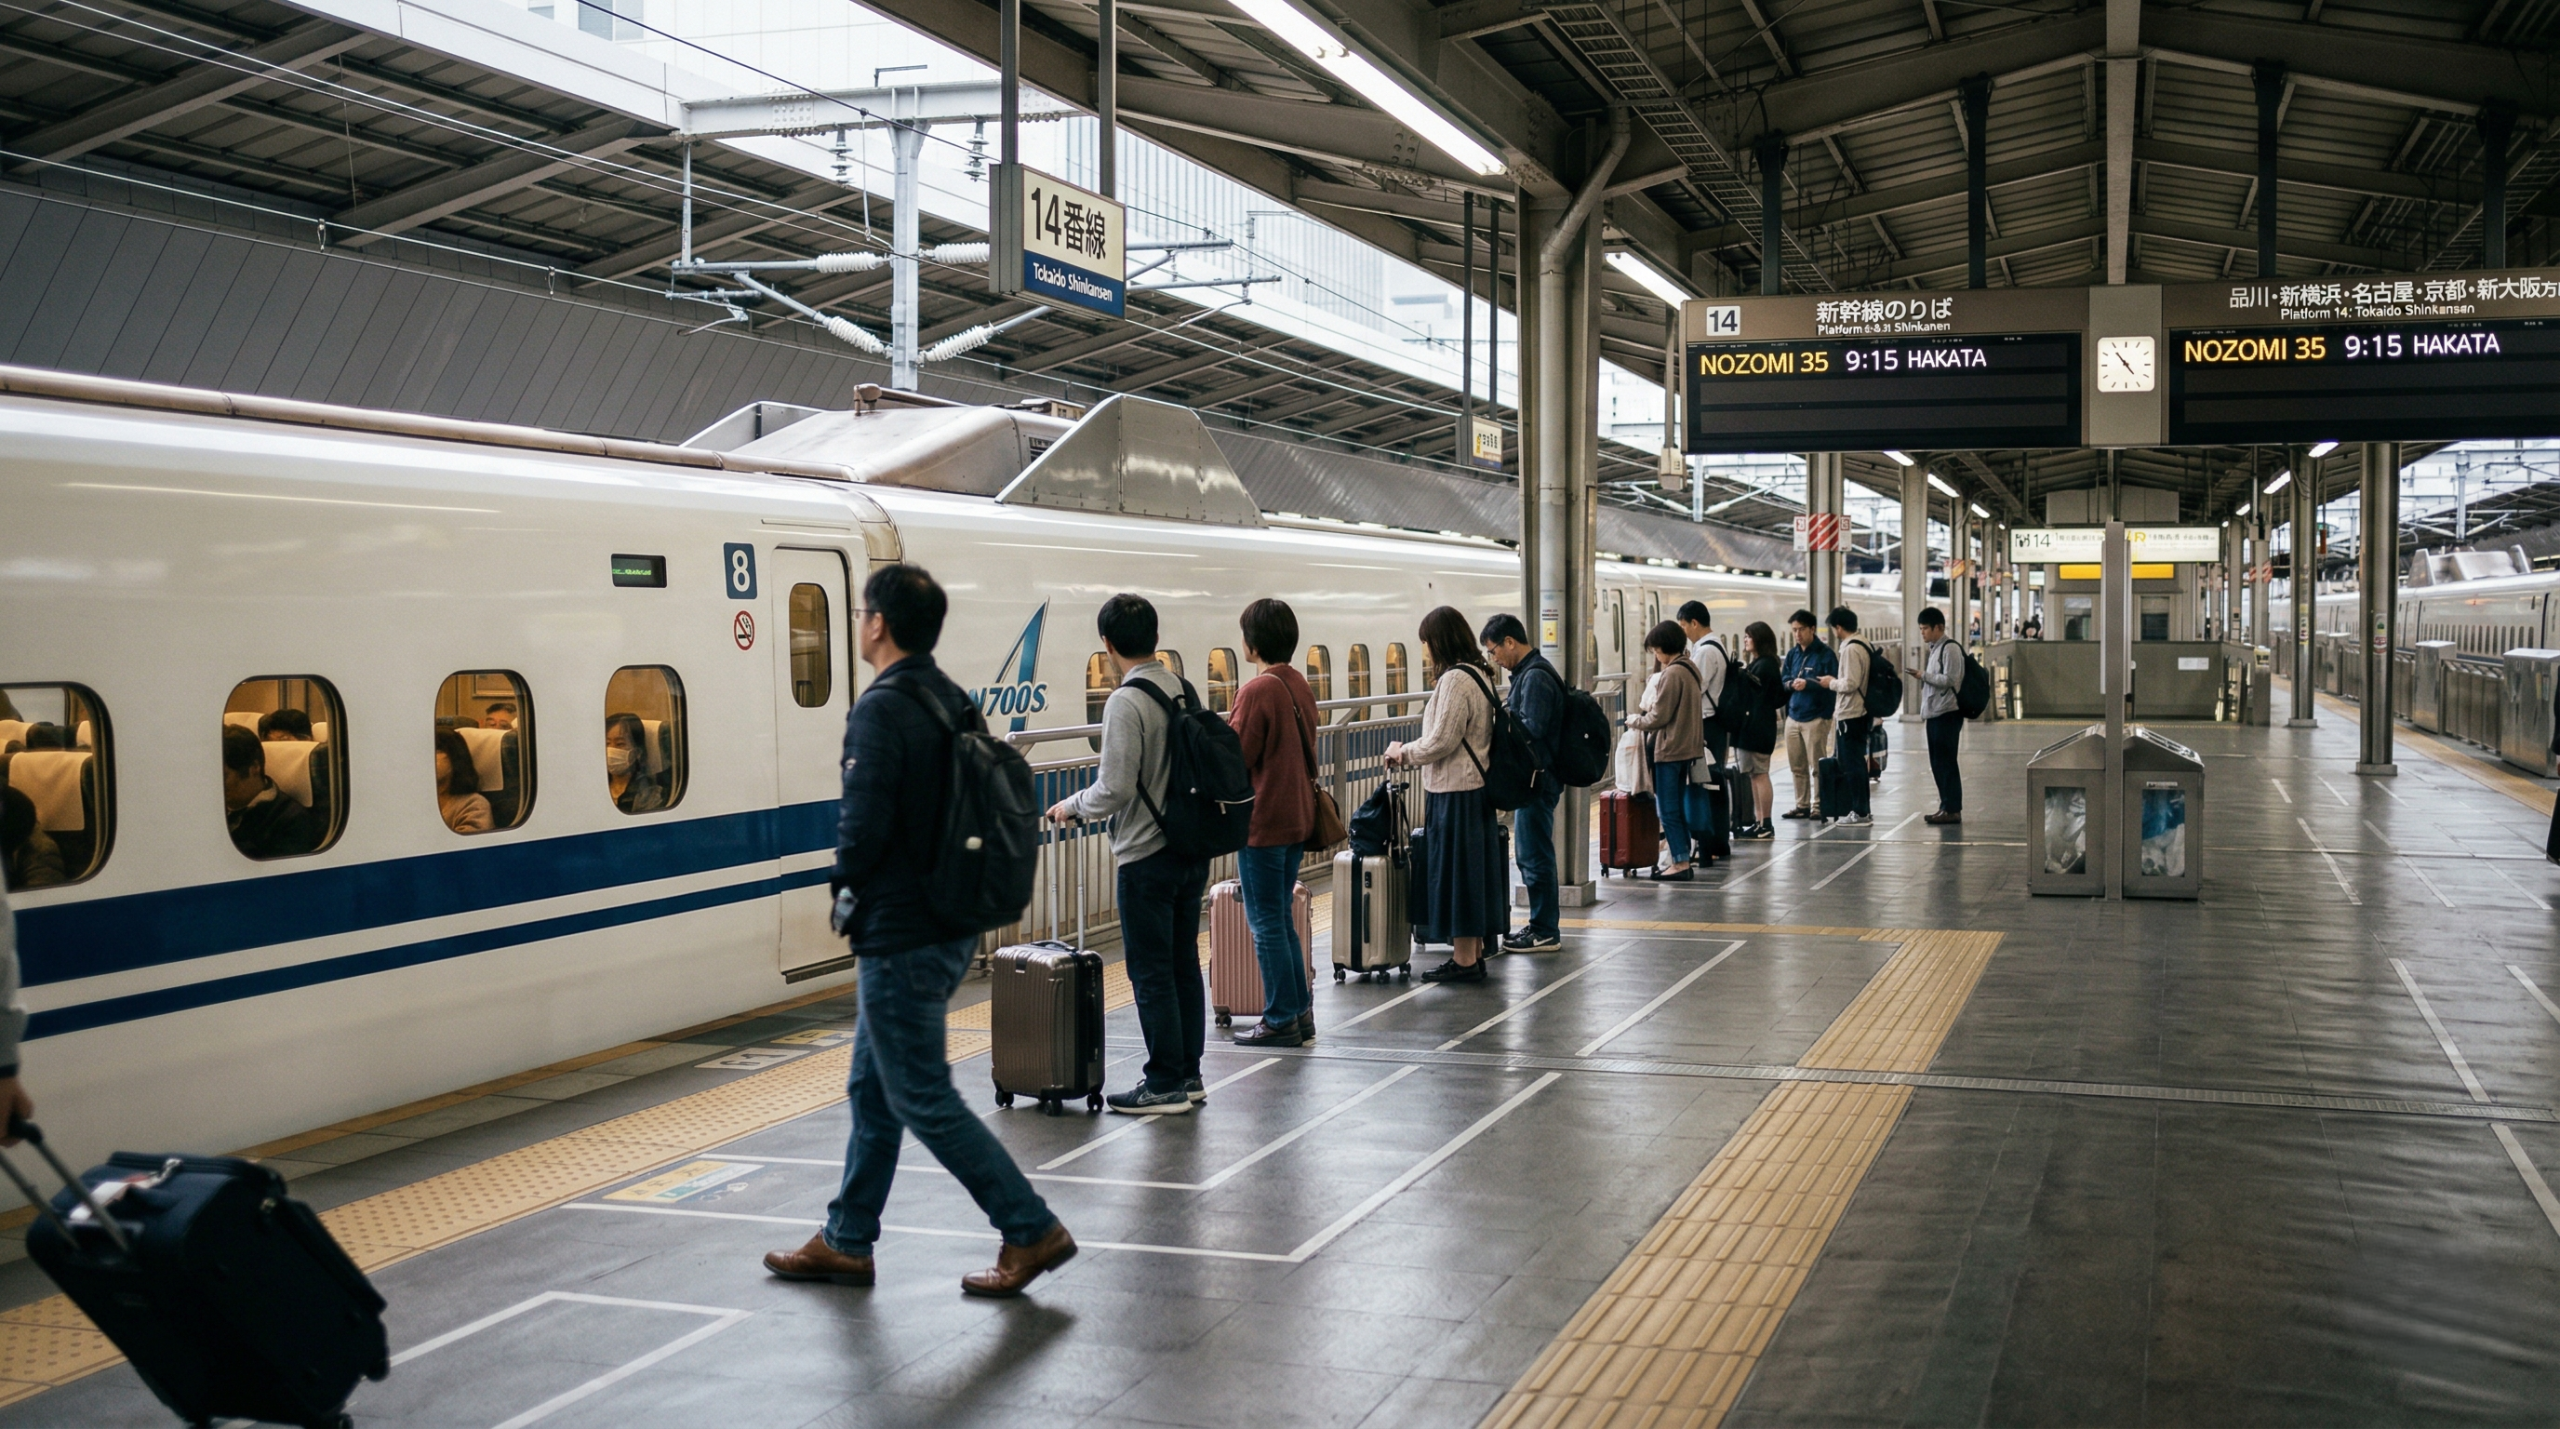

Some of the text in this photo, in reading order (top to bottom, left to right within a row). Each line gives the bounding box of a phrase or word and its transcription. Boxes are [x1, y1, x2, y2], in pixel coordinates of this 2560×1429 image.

[1031, 187, 1107, 260] 14番線
[1033, 262, 1113, 302] Tokaido Shinkansen
[1709, 310, 1738, 333] 14
[1815, 297, 1953, 323] 新幹線のりば
[2354, 304, 2401, 318] Tokaido
[1700, 348, 1987, 376] NOZOMI 35 9:15 HAKATA
[2184, 333, 2501, 363] NOZOMI 35 9:15 HAKATA
[2033, 533, 2051, 548] 14
[732, 550, 750, 592] 8
